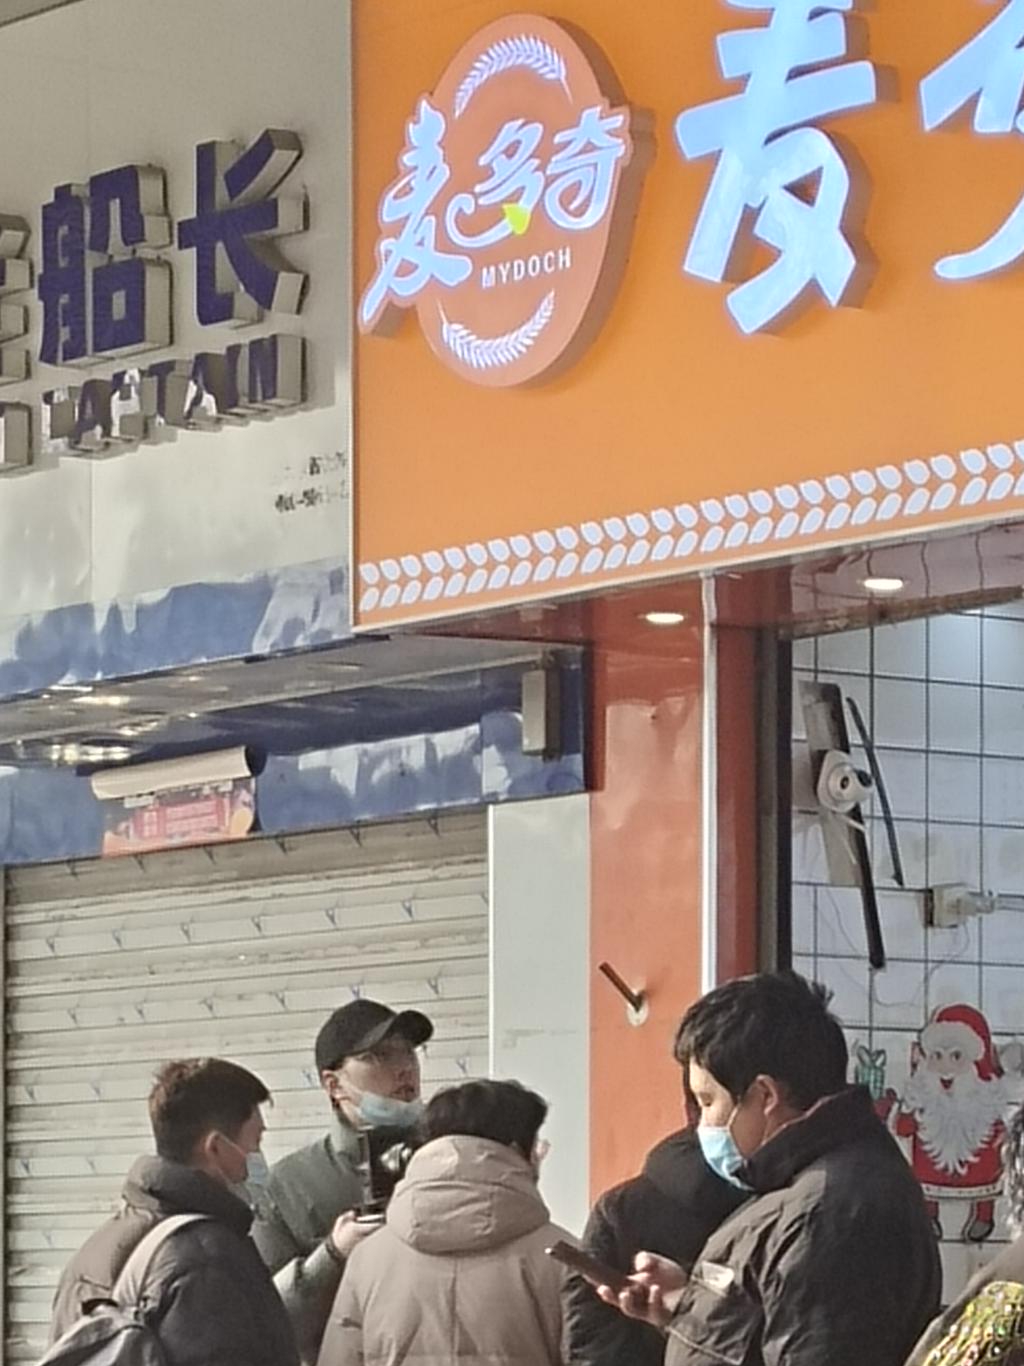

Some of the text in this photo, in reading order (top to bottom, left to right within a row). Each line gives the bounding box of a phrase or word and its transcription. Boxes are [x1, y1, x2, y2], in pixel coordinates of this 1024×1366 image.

[0, 128, 306, 378] 船长
[361, 98, 627, 325] 麦多奇
[481, 246, 572, 290] MYDOCH
